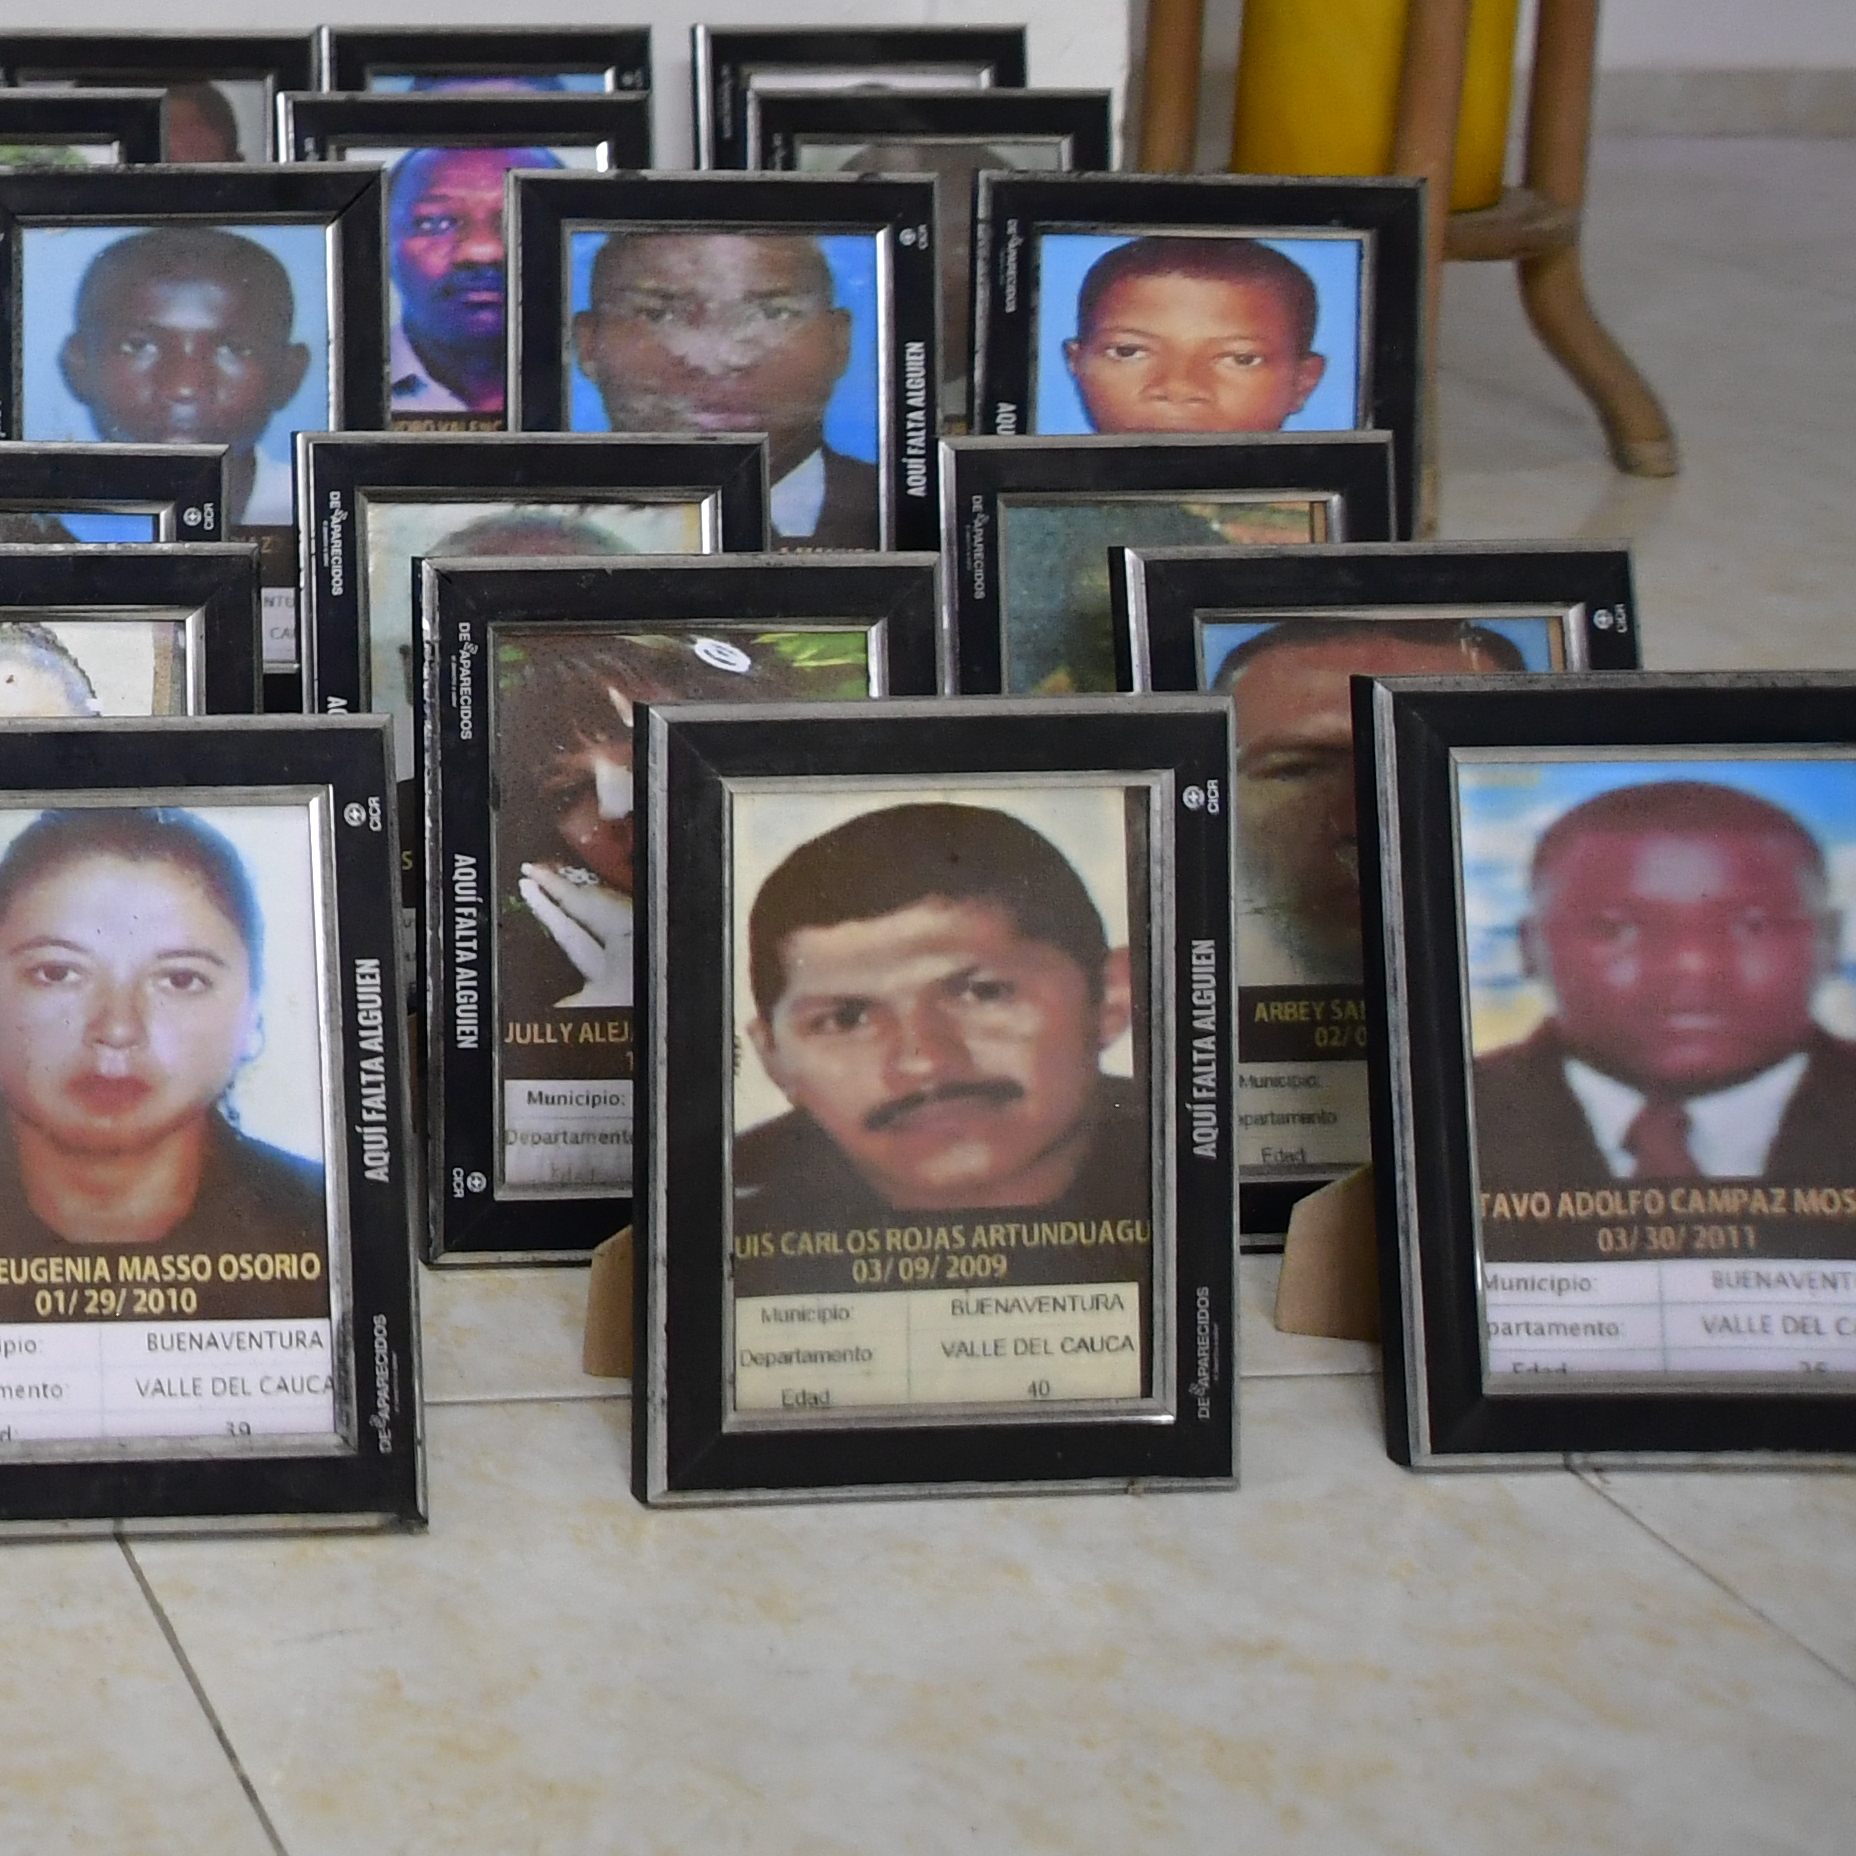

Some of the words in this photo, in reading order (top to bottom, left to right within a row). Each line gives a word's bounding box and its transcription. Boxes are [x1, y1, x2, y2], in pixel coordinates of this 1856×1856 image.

[904, 341, 926, 407] ALGUIEN
[904, 410, 926, 454] FALTA
[1206, 779, 1219, 814] CICR
[368, 796, 383, 832] CICR
[453, 853, 484, 904] AQUÍ
[454, 907, 478, 965] FALTA
[1191, 939, 1216, 1033] ALGUIEN
[355, 958, 384, 1053] ALGUIEN
[455, 969, 479, 1049] ALGUIEN
[504, 1022, 573, 1044] JULLY
[1192, 1036, 1216, 1101] FALTA
[361, 1056, 387, 1121] FALTA
[527, 1090, 626, 1108] Municipio:
[1186, 1104, 1217, 1161] AQUÍ
[357, 1125, 390, 1183] AQUÍ
[453, 1168, 464, 1198] CICR
[1557, 1189, 1666, 1217] ADOLFO
[1671, 1187, 1786, 1215] CAMPAZ
[781, 1227, 878, 1256] CARLOS
[887, 1224, 965, 1252] ROJAS
[118, 1254, 212, 1283] MASSO
[218, 1251, 321, 1282] OSORIO
[946, 1254, 1008, 1280] 2009
[133, 1286, 197, 1315] 2010
[951, 1293, 1126, 1317] BUENAVENTURA
[146, 1329, 324, 1352] BUENAVENTURA
[1701, 1314, 1770, 1336] VALLE
[1782, 1314, 1830, 1335] DEL
[941, 1337, 1007, 1358] VALLE
[1013, 1336, 1054, 1357] DEL
[1061, 1334, 1136, 1354] CAUCA
[136, 1377, 202, 1398] VALLE
[212, 1376, 251, 1397] DEL
[260, 1374, 334, 1395] CAUCA
